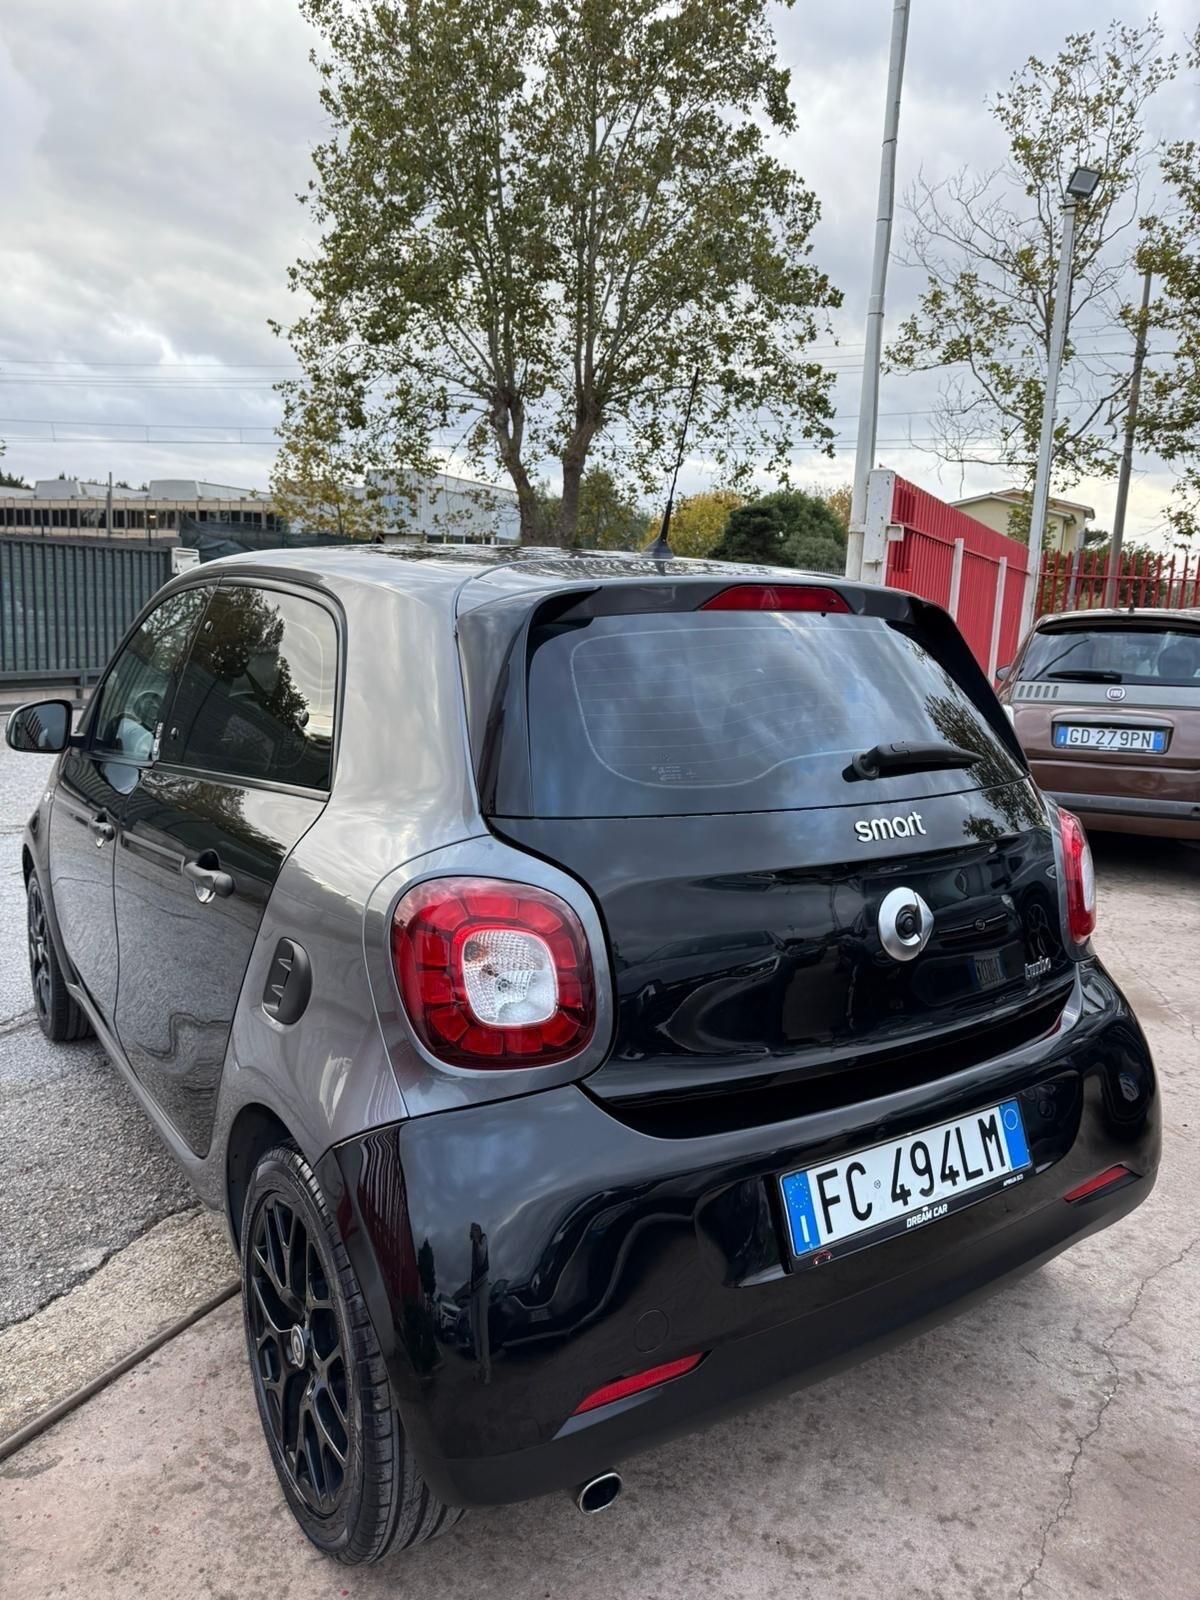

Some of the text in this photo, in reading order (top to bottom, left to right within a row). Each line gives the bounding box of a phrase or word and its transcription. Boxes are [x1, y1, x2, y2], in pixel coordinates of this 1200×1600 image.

[854, 811, 927, 843] smart
[815, 1161, 873, 1235] FC
[890, 1114, 1006, 1206] 494LM
[906, 1203, 948, 1228] DREAM CAR
